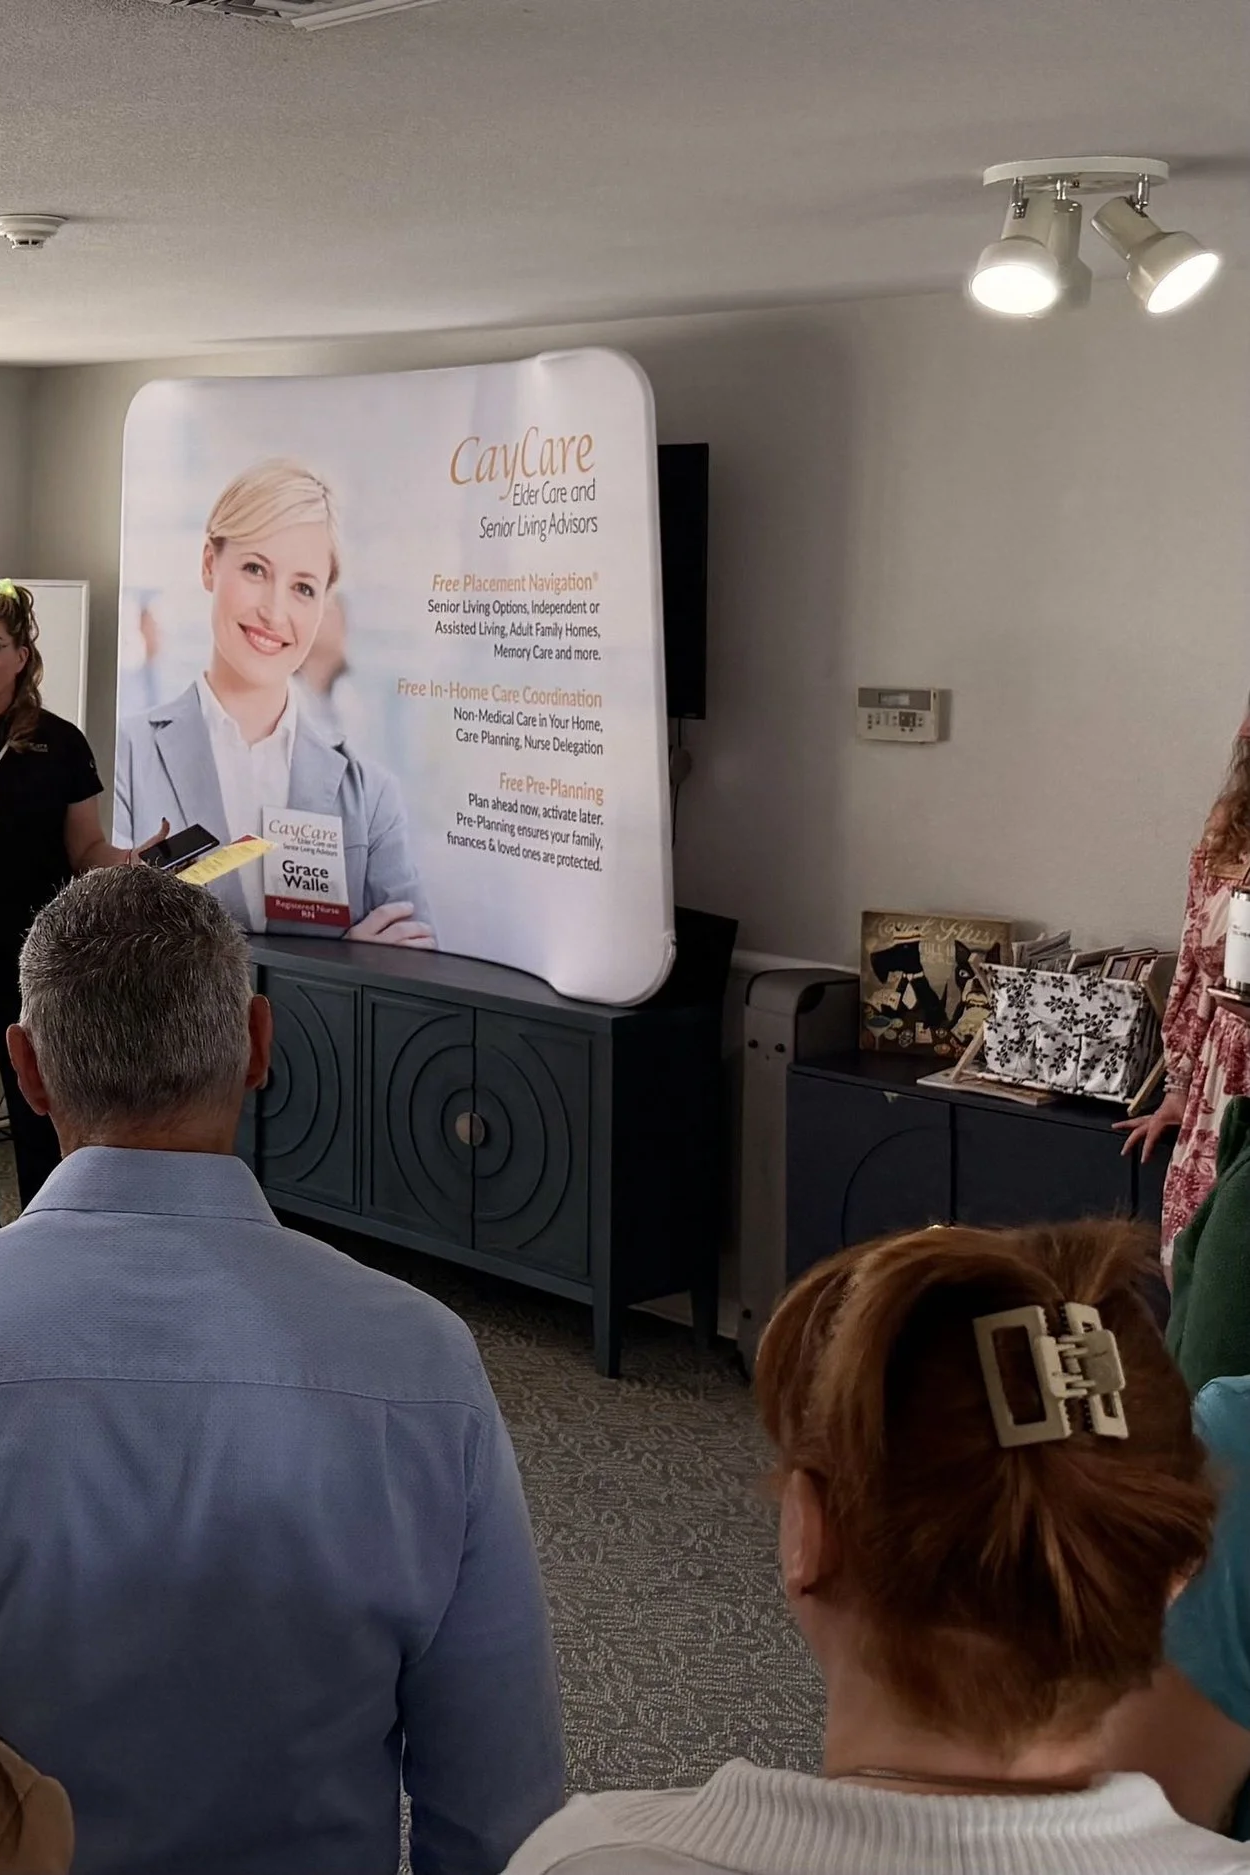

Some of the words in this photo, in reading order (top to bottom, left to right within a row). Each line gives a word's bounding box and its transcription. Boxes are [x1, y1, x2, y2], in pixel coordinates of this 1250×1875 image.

[450, 426, 595, 501] CayCare
[512, 484, 539, 506] Elder
[541, 481, 568, 504] Care
[570, 478, 596, 501] and
[479, 516, 515, 539] Senior
[517, 514, 547, 542] Living
[549, 511, 598, 535] Advisors
[432, 574, 460, 592] Free
[463, 574, 526, 592] Placement
[427, 599, 460, 613] Senior
[463, 600, 490, 617] Living
[492, 600, 530, 617] Options,
[531, 600, 587, 616] Independent
[589, 602, 600, 614] or
[434, 620, 476, 635] Assisted
[478, 621, 508, 639] Living,
[509, 622, 533, 636] Adult
[535, 622, 563, 640] Family
[565, 623, 601, 638] Homes,
[493, 643, 531, 661] Memory
[533, 645, 553, 659] Care
[555, 646, 572, 660] and
[574, 649, 602, 661] more.
[397, 678, 427, 696] Free
[430, 680, 489, 700] In-Home
[491, 684, 519, 703] Care
[522, 685, 602, 708] Coordination
[453, 706, 514, 725] Non-Medical
[516, 712, 537, 727] Care
[538, 713, 548, 727] in
[549, 714, 570, 730] Your
[571, 716, 603, 733] Home,
[456, 728, 479, 743] Care
[481, 730, 523, 751] Planning,
[524, 735, 551, 751] Nurse
[552, 736, 603, 756] Delegation
[499, 772, 524, 792] Free
[526, 775, 604, 806] Pre-Planning
[468, 793, 490, 809] Plan
[491, 797, 518, 813] ahead
[520, 803, 541, 818] now,
[542, 805, 578, 822] activate
[579, 808, 604, 826] later.
[268, 820, 338, 843] CayCare
[456, 812, 516, 837] Pre-Planning
[517, 824, 549, 840] ensures
[550, 831, 571, 844] your
[572, 830, 604, 851] family,
[447, 831, 487, 850] finances
[488, 838, 496, 852] &
[497, 840, 521, 857] loved
[522, 847, 542, 861] ones
[542, 851, 556, 864] are
[556, 854, 603, 872] protected.
[282, 860, 329, 879] Grace
[283, 873, 329, 893] Walle
[275, 899, 316, 912] Registered
[316, 904, 340, 915] Nurse
